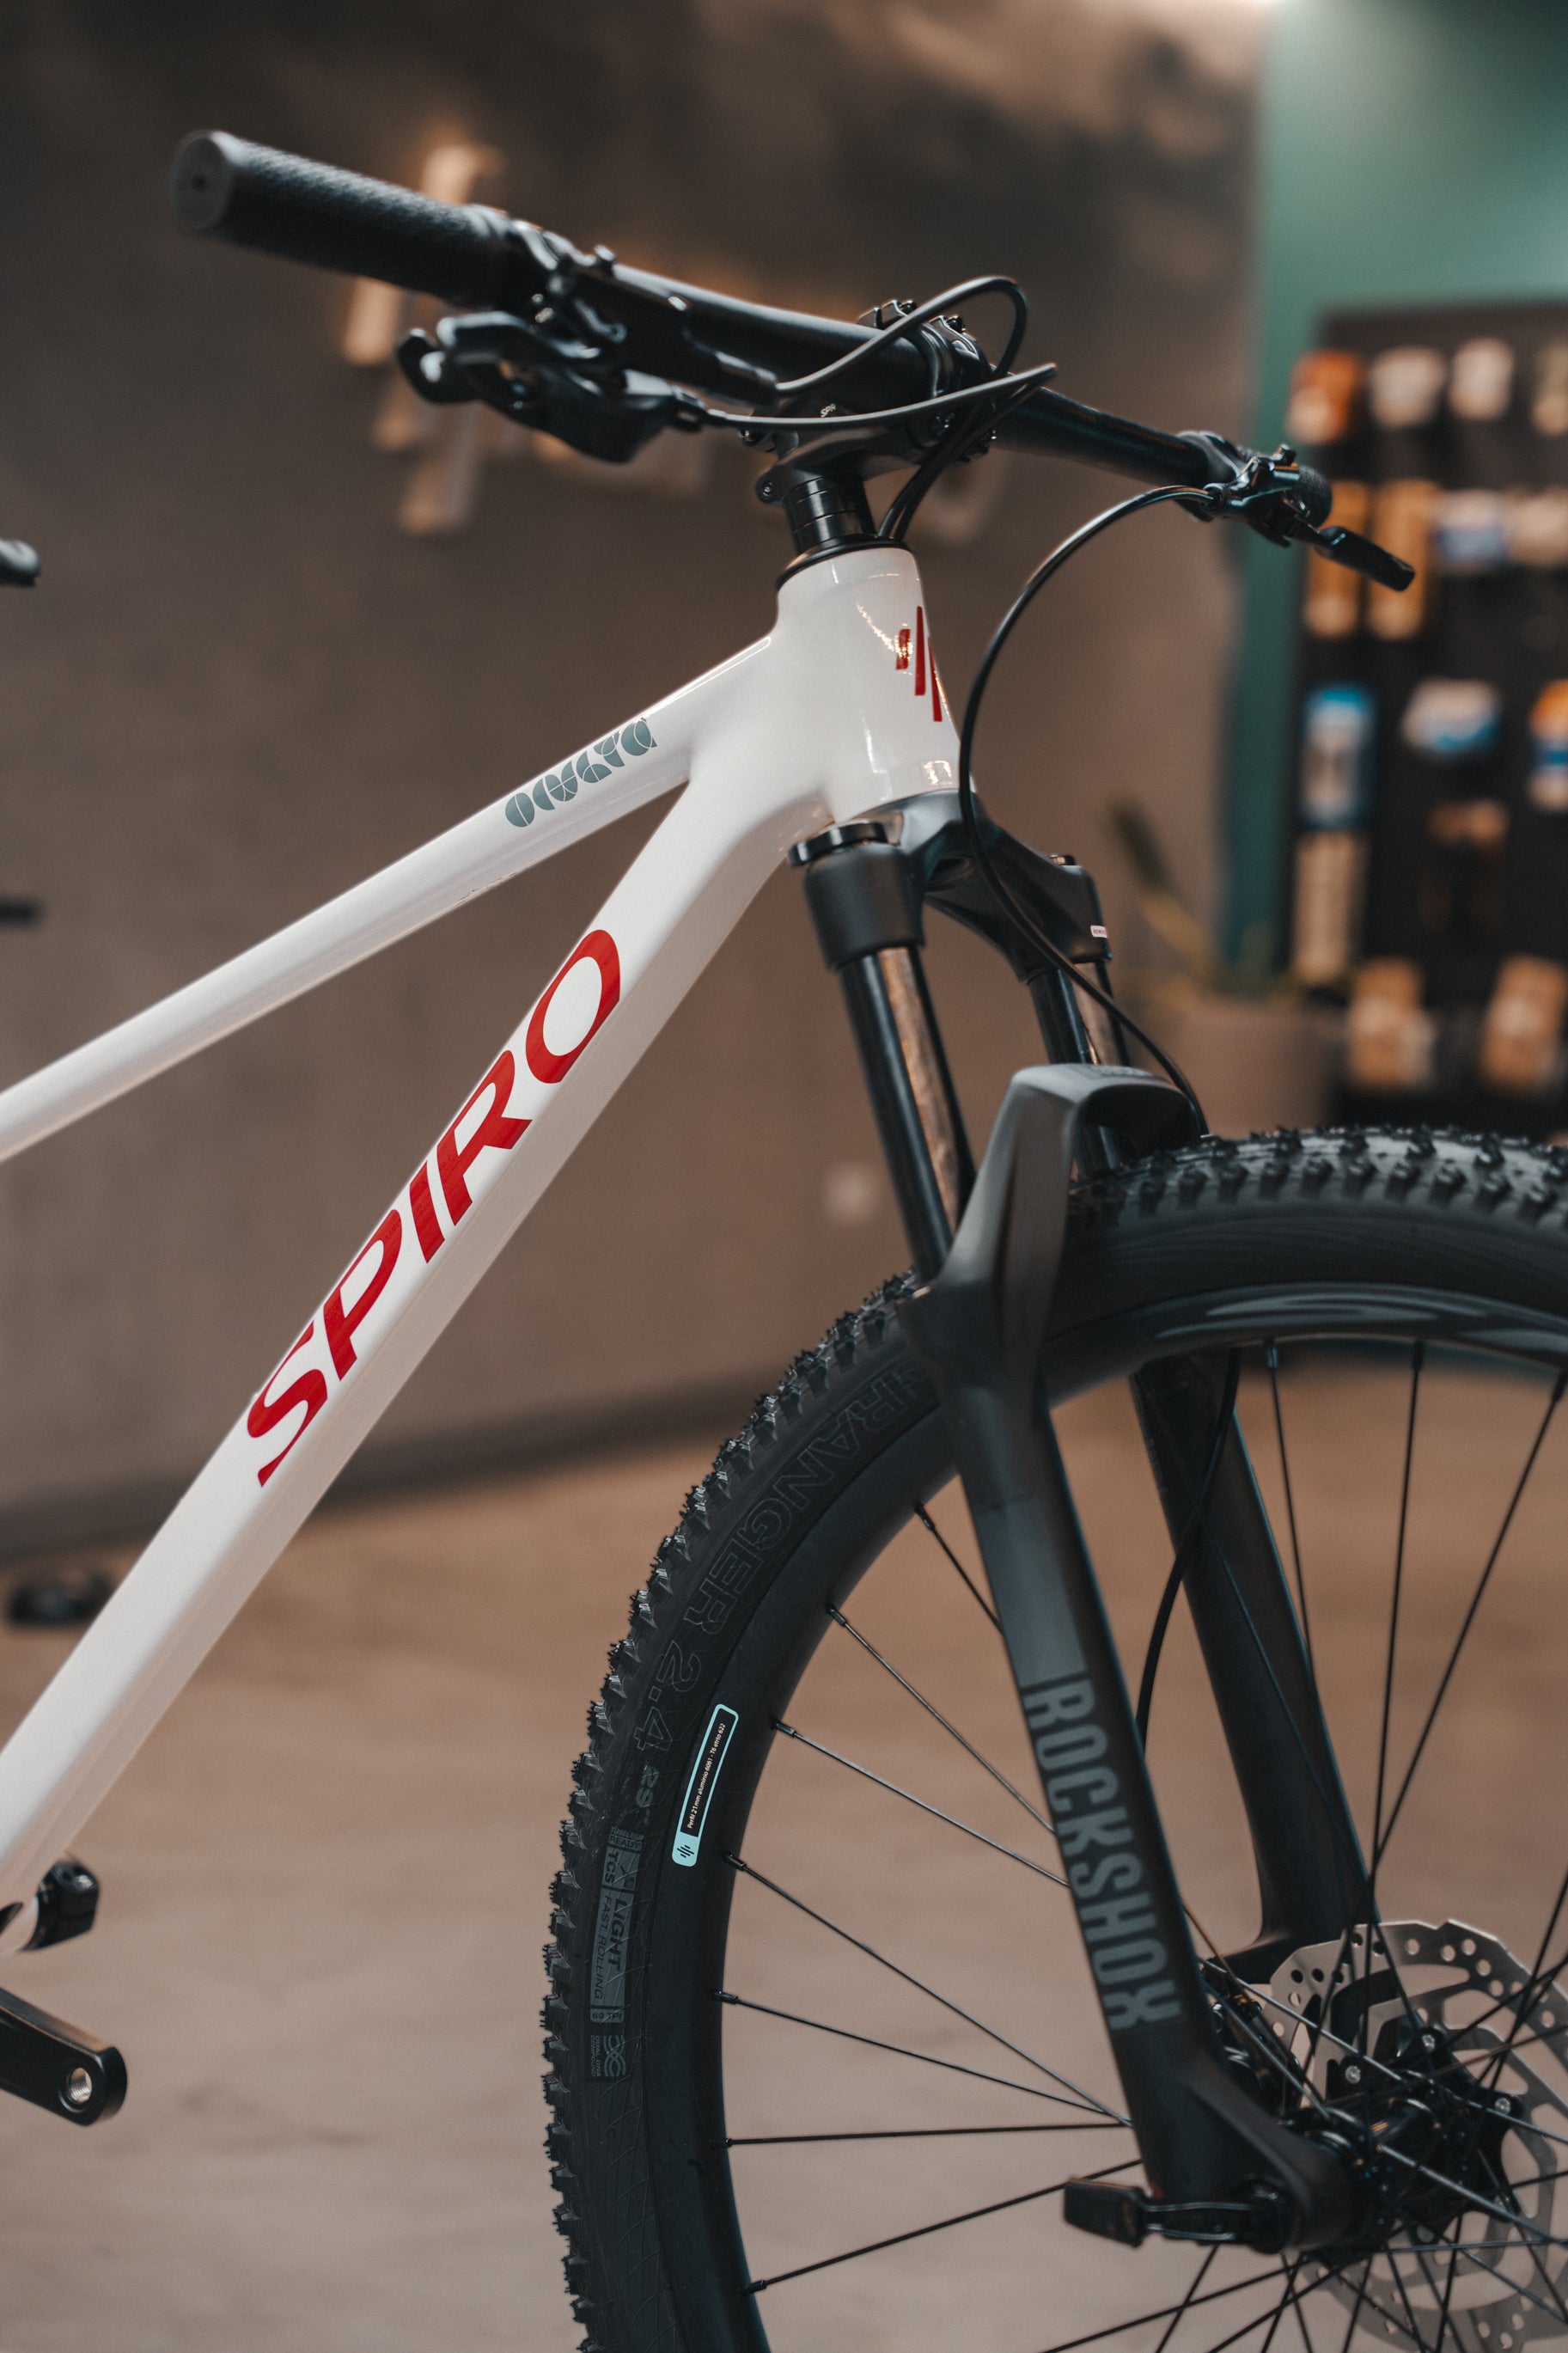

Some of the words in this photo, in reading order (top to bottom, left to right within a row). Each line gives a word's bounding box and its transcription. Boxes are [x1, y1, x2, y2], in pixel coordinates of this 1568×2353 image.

[247, 929, 620, 1488] SPIRO
[683, 1378, 910, 1634] RANGER
[634, 1641, 702, 1751] 2.4
[605, 1851, 619, 1884] TCS
[609, 1836, 642, 1850] READY
[1022, 1679, 1182, 2029] ROCKSHOX
[601, 1895, 612, 1931] FAST
[608, 1898, 627, 1971] LIGHT
[595, 1934, 607, 2000] ROLLING
